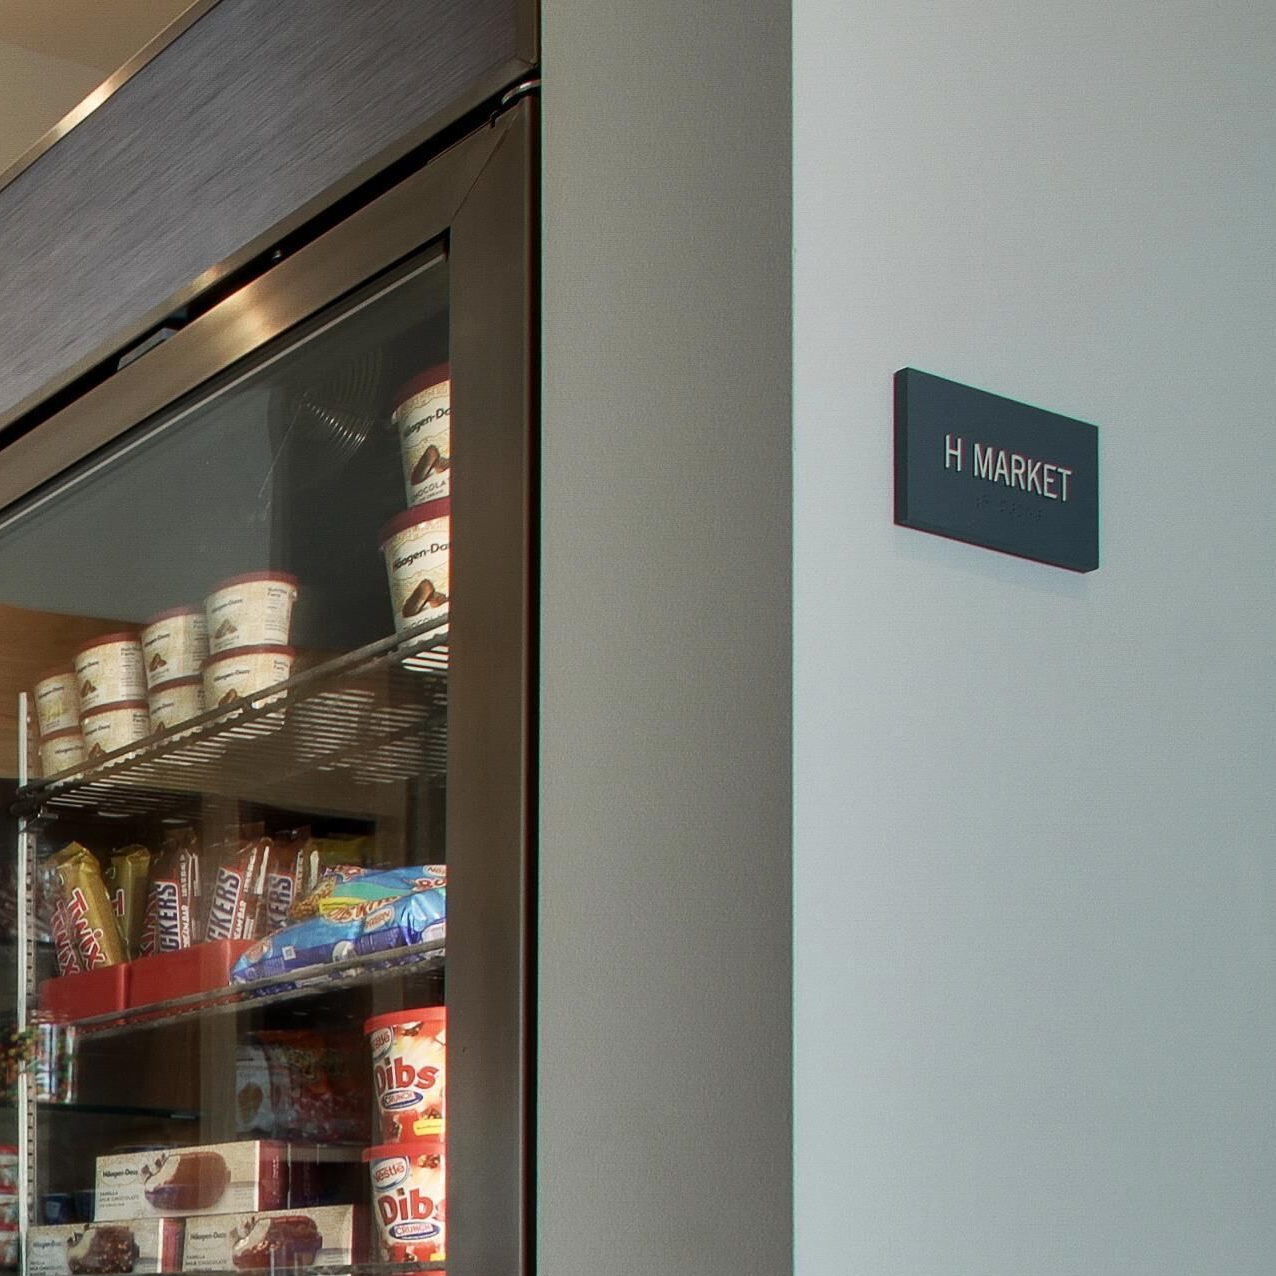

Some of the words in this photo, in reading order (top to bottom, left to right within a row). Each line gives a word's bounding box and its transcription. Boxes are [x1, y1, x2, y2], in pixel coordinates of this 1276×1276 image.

[945, 434, 962, 472] H
[973, 443, 1072, 502] MARKET
[156, 883, 179, 951] CKERS
[207, 868, 240, 940] CKERS
[374, 1057, 439, 1094] Dibs
[396, 1223, 432, 1237] CRUNCH
